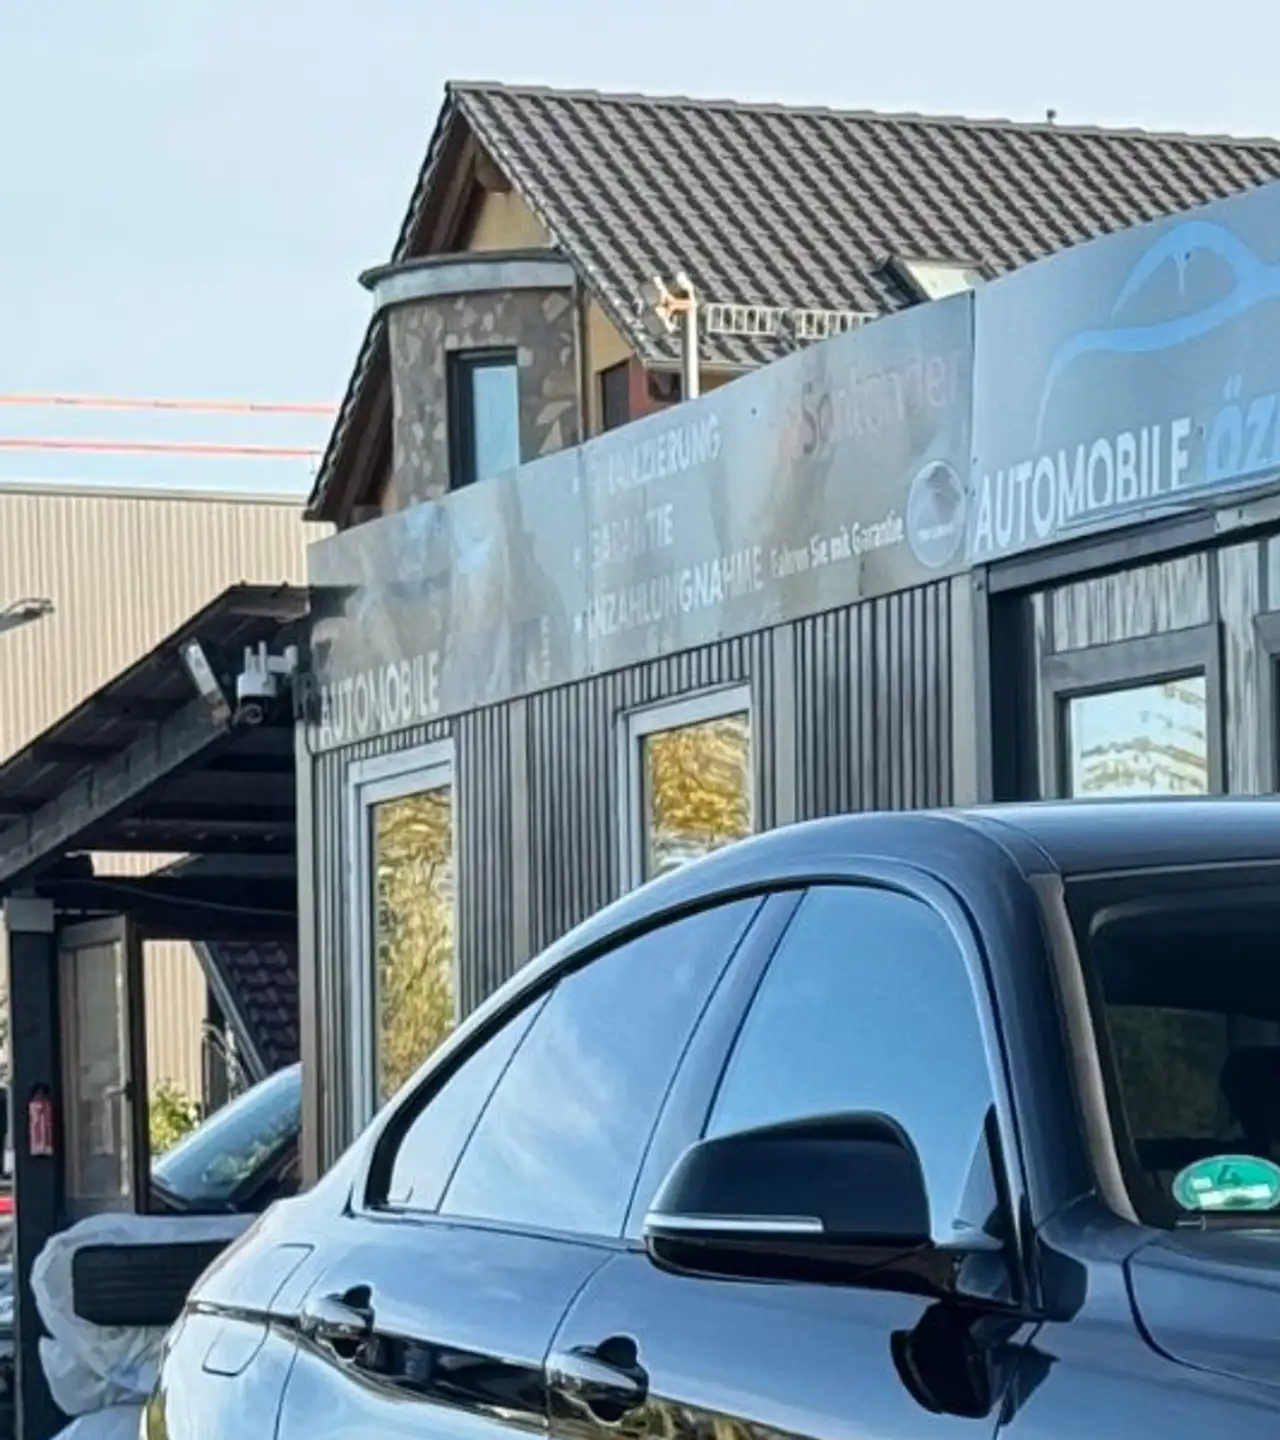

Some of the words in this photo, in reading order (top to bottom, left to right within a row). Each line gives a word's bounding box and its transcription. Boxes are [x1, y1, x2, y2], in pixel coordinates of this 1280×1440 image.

[972, 416, 1191, 553] AUTOMOBILE
[319, 650, 440, 746] AUTOMOBILE
[1217, 1163, 1244, 1187] 4
